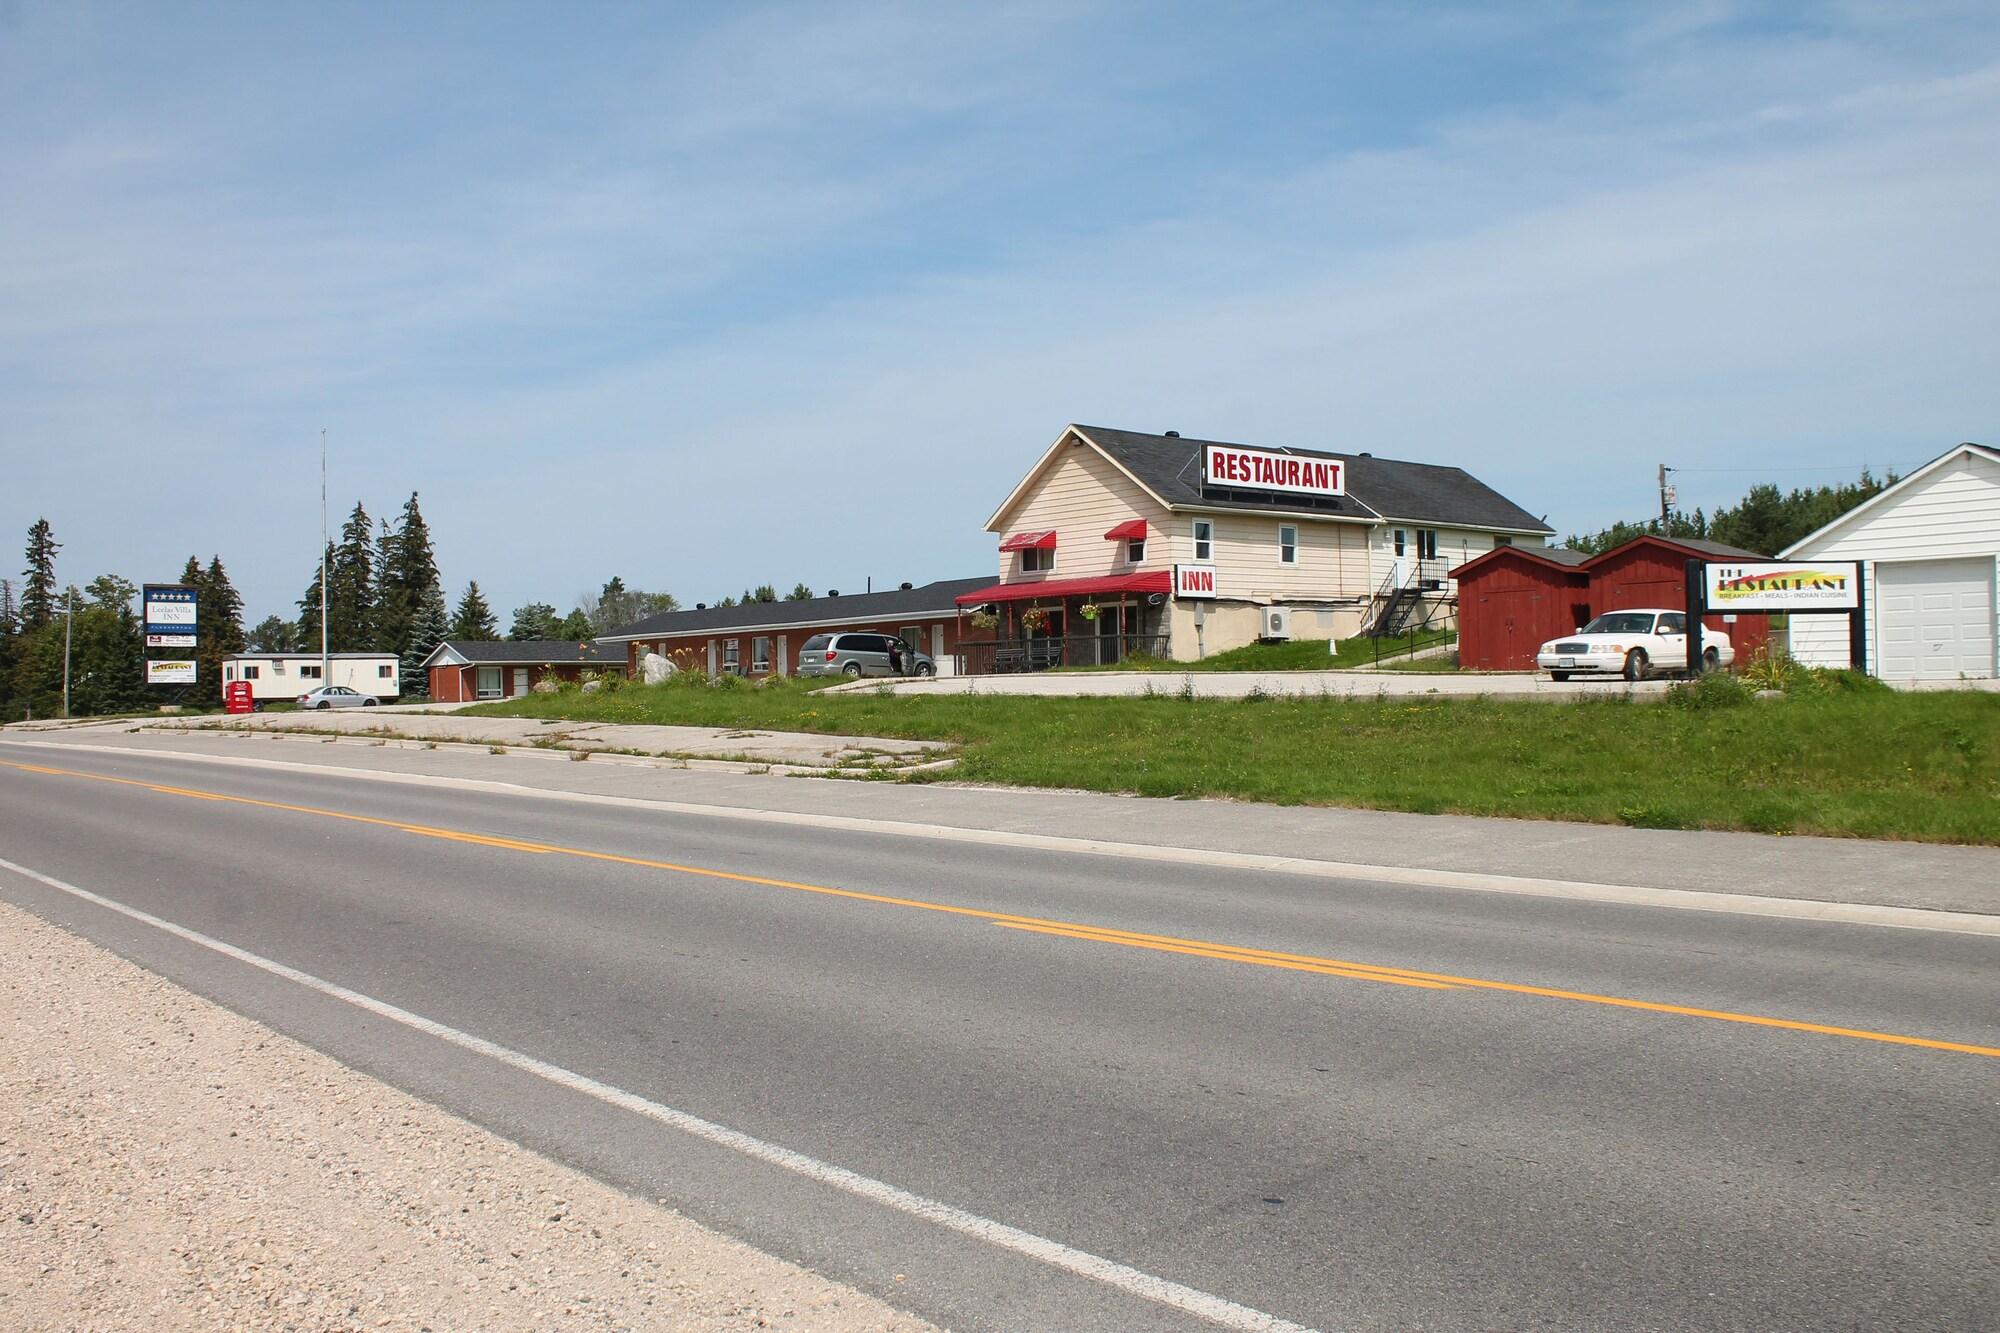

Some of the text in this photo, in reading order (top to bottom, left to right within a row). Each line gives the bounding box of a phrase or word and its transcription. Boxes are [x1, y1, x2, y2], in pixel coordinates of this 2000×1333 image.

[1212, 451, 1341, 490] RESTAURANT
[1181, 570, 1213, 592] INN
[1718, 578, 1847, 591] RESTAURANT
